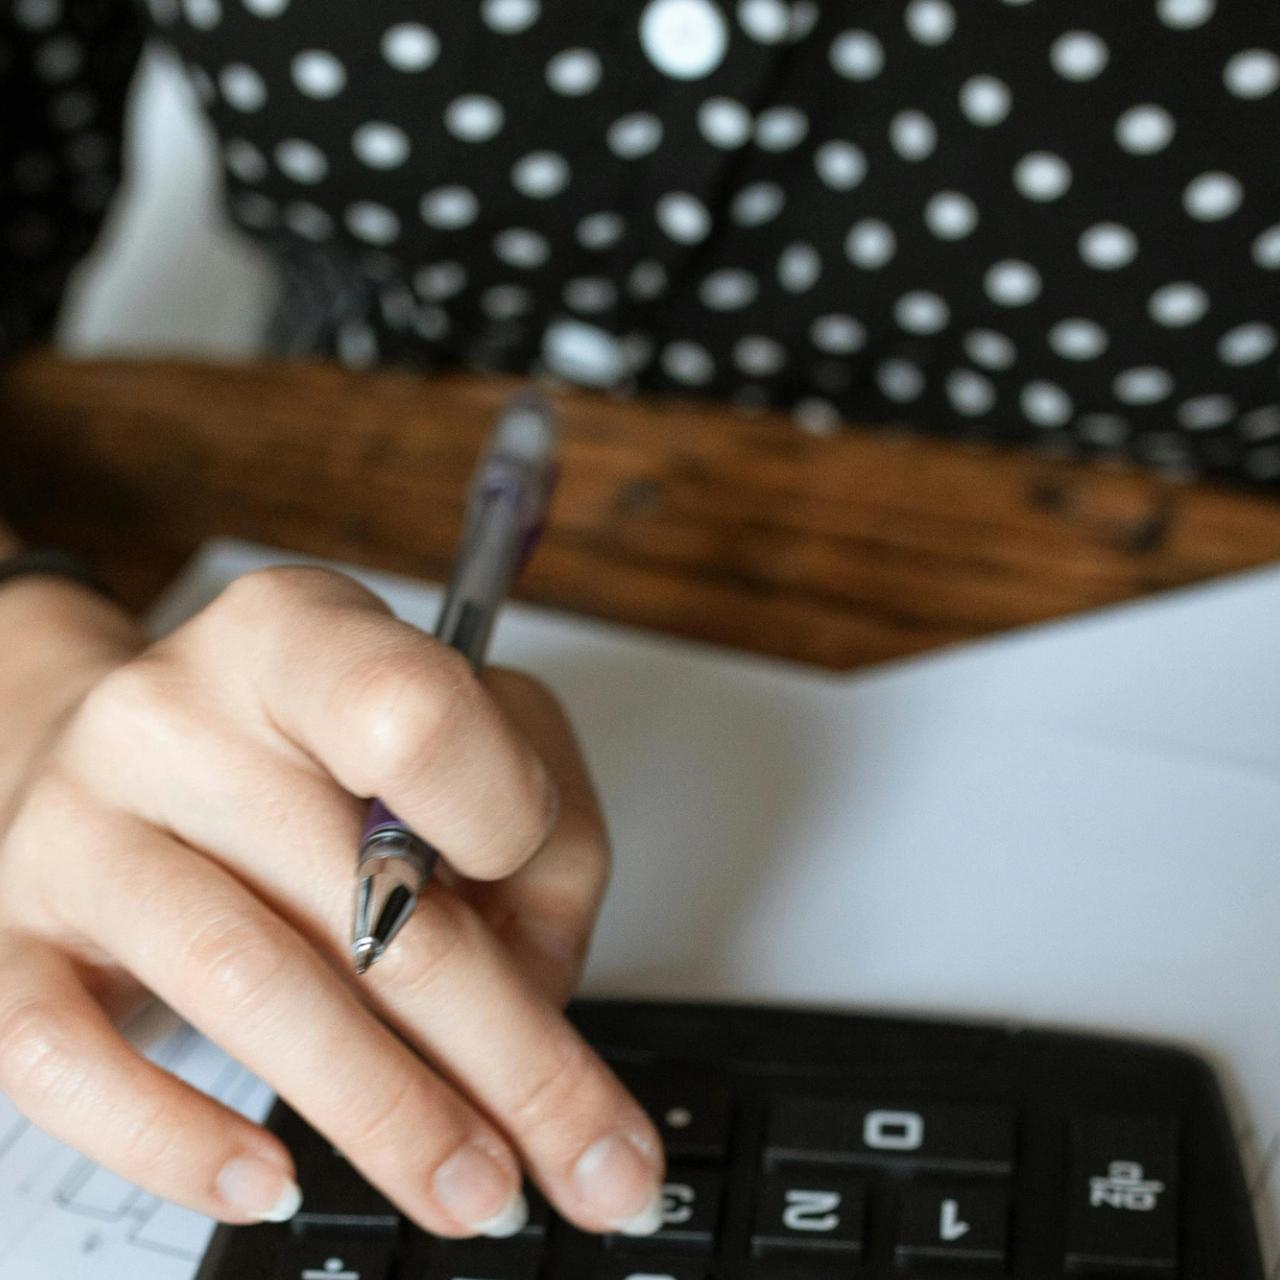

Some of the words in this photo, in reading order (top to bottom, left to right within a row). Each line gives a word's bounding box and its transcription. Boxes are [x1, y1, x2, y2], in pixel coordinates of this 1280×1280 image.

[864, 1111, 922, 1149] 0
[784, 1191, 839, 1230] 2
[941, 1201, 967, 1239] 1
